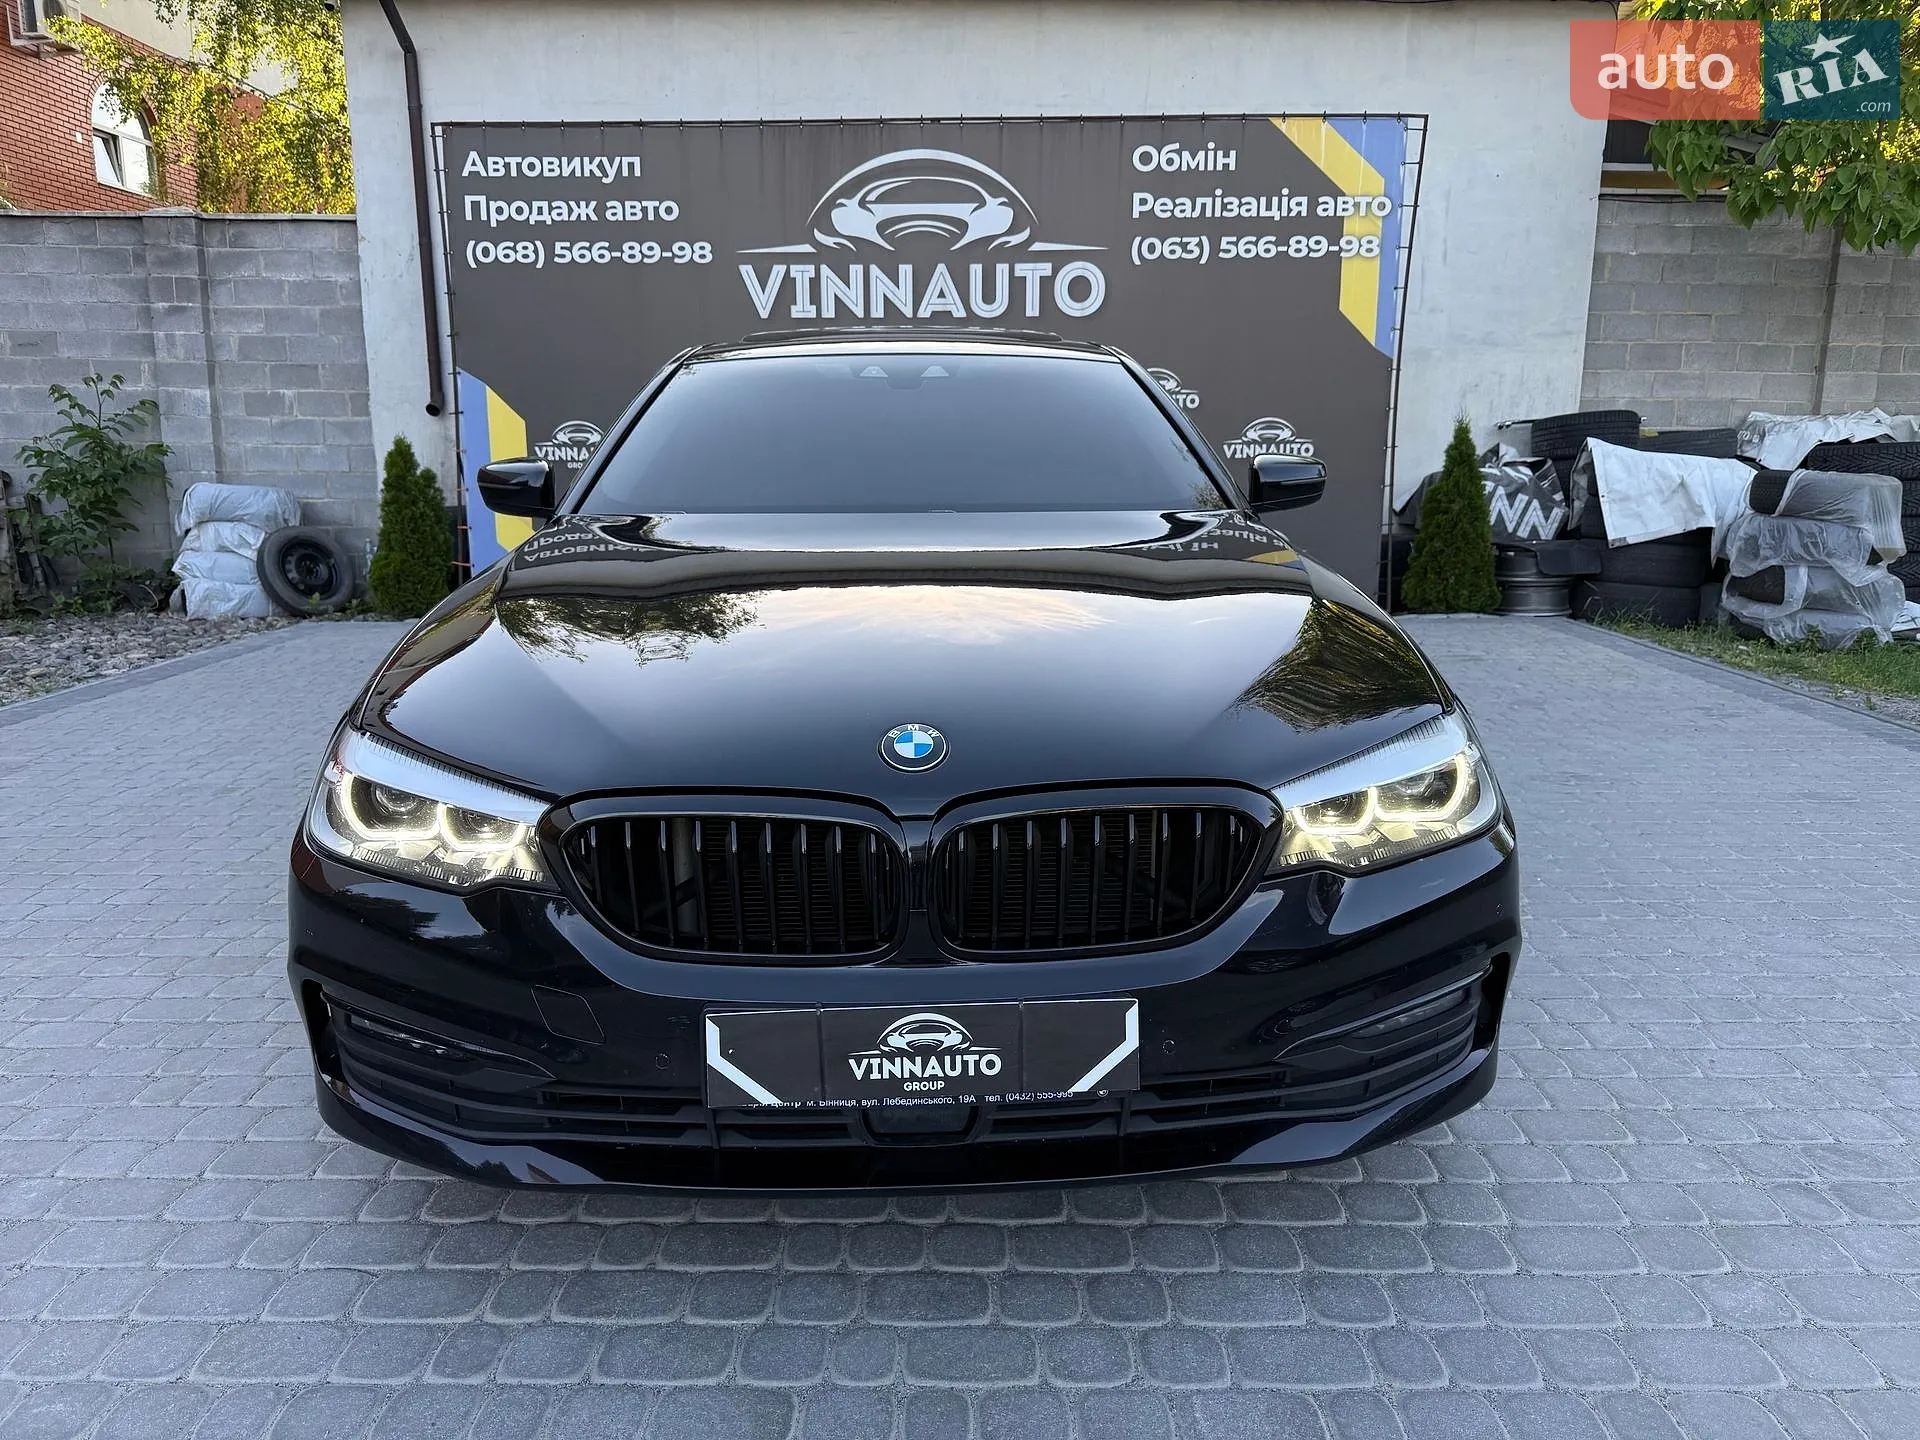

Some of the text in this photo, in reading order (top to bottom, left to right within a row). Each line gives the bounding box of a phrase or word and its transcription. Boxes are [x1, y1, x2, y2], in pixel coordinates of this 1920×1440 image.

[461, 150, 642, 183] Автовикуп
[1132, 142, 1237, 172] Обмін
[464, 195, 680, 227] Продаж авто
[1132, 187, 1392, 221] Реалізація авто
[466, 240, 713, 268] (068) 566-89-98
[1131, 235, 1380, 265] (063) 566-89-98
[738, 261, 1106, 319] VINNAUTO
[888, 723, 940, 739] BMW
[849, 1053, 1002, 1081] VINNAUTO
[903, 1081, 945, 1091] GROUP
[861, 1098, 880, 1108] вул.
